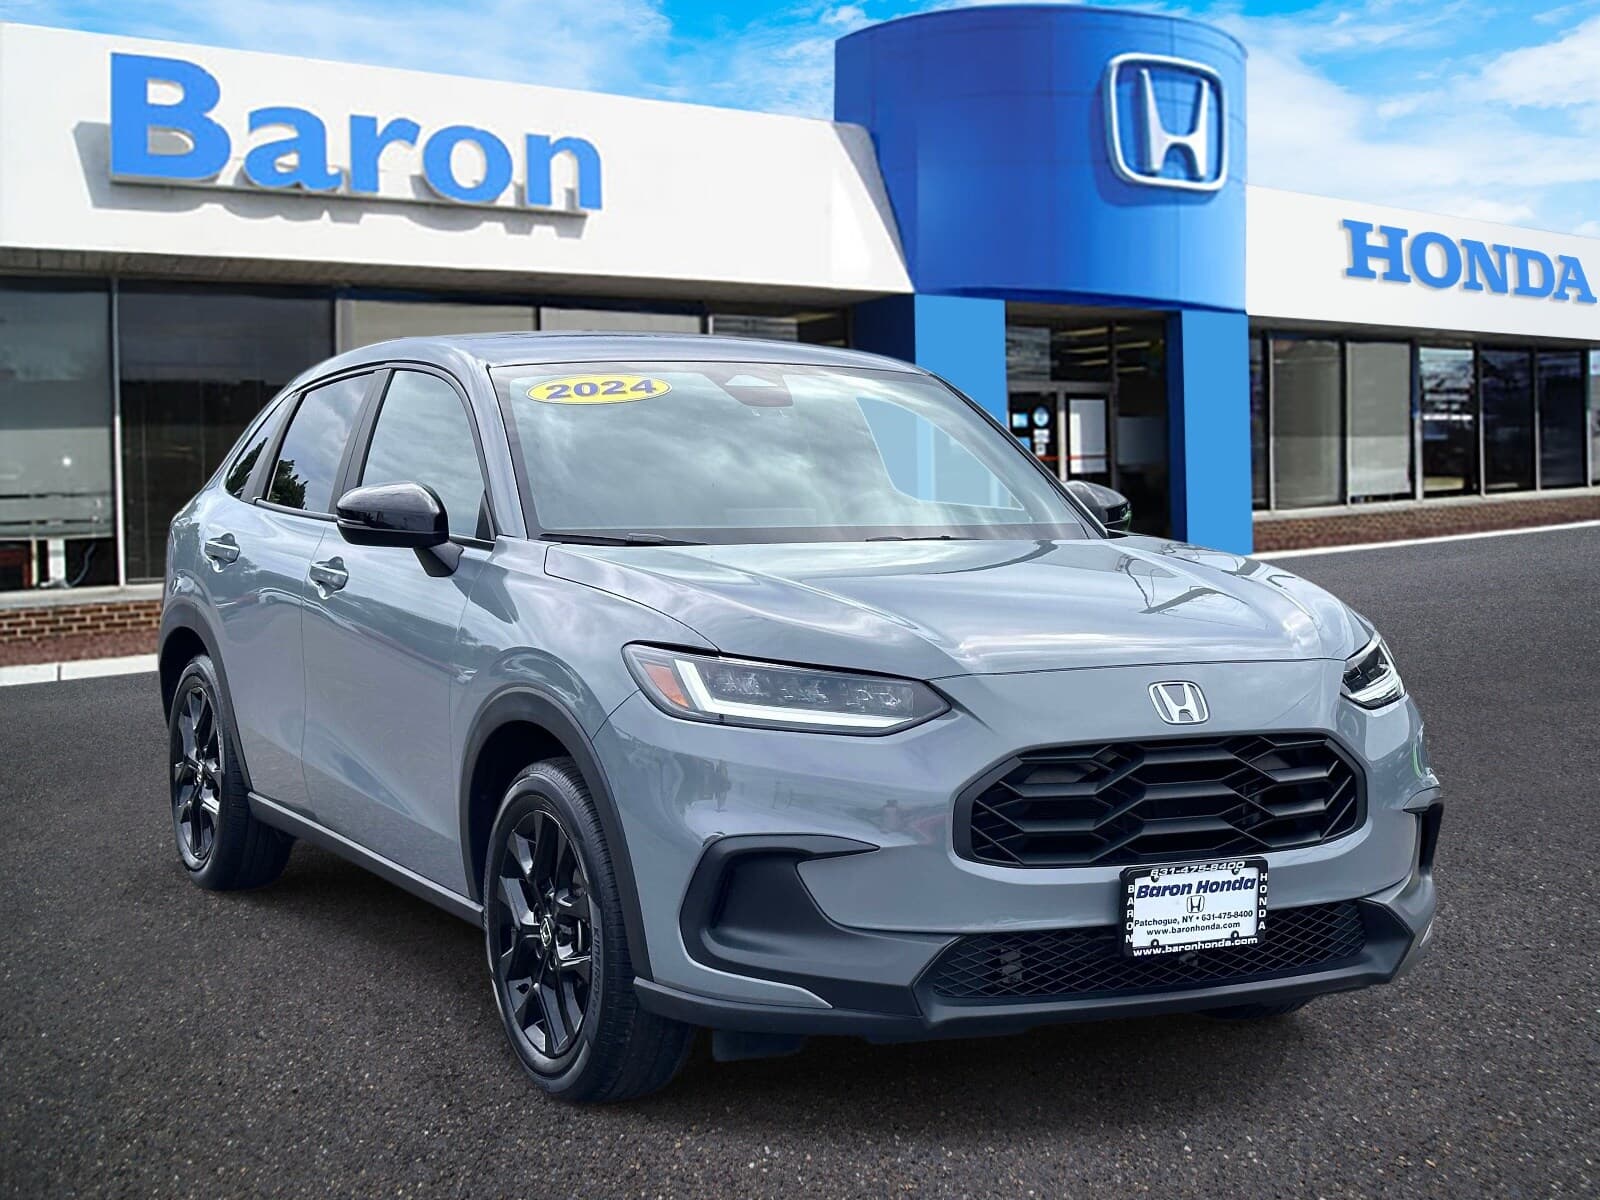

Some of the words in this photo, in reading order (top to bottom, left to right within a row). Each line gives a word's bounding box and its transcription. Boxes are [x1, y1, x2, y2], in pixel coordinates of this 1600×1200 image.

[109, 51, 603, 211] Baron
[1342, 218, 1598, 304] HONDA
[545, 380, 656, 400] 2024
[1136, 883, 1192, 899] Baron
[1196, 876, 1256, 894] Honda
[1258, 872, 1268, 930] HONDA
[1125, 884, 1135, 944] BARON
[1134, 918, 1180, 927] Patchogue,
[1182, 915, 1194, 923] NY
[1201, 910, 1253, 921] 631-475-8400
[1146, 922, 1241, 936] www.baronhonda.com
[1133, 938, 1258, 957] www.baronhonda.com
